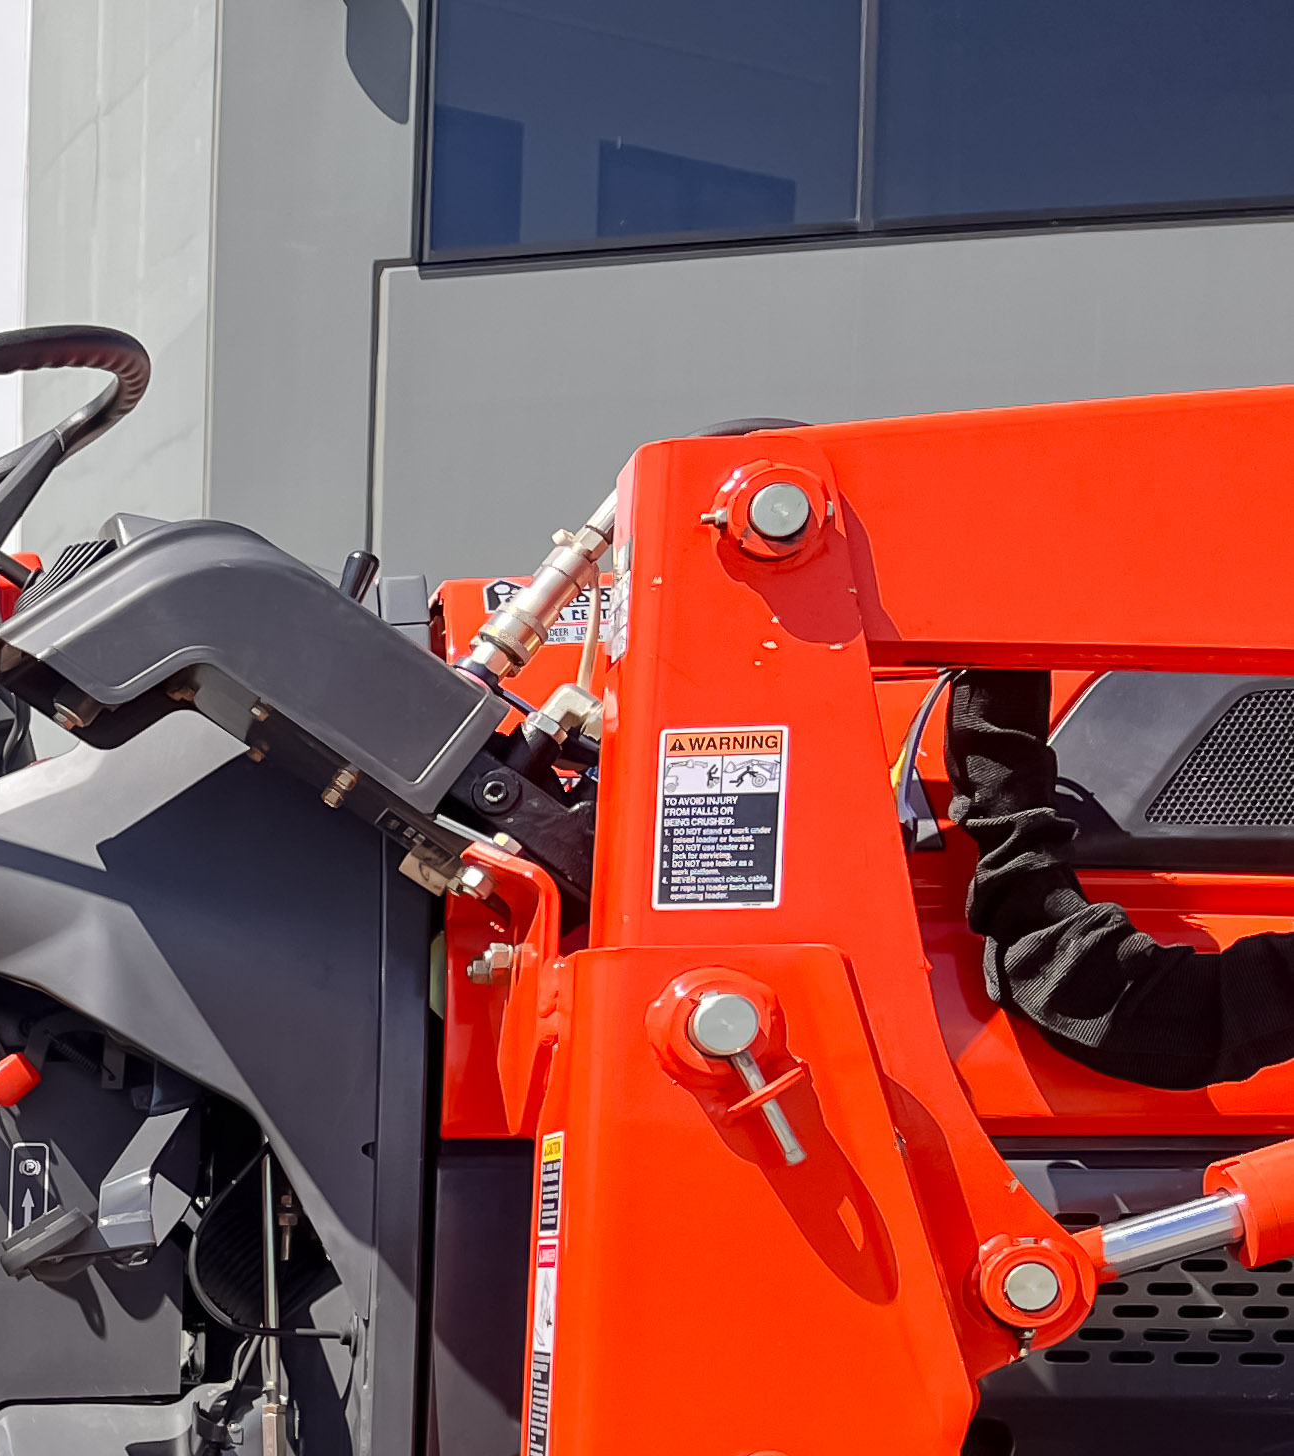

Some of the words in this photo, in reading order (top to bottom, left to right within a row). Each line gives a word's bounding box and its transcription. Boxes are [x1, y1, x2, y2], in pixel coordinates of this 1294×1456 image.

[689, 735, 778, 751] WARNING
[665, 798, 677, 806] TO
[678, 797, 705, 806] AVOID
[706, 796, 738, 805] INJURY
[664, 808, 690, 816] FROM
[691, 807, 718, 816] FALLS
[720, 807, 733, 815] OR
[664, 818, 690, 827] BEING
[691, 817, 735, 826] CRUSHED:
[673, 828, 685, 836] DO
[673, 844, 684, 852] DO
[685, 844, 701, 852] NOT
[672, 860, 684, 868] DO
